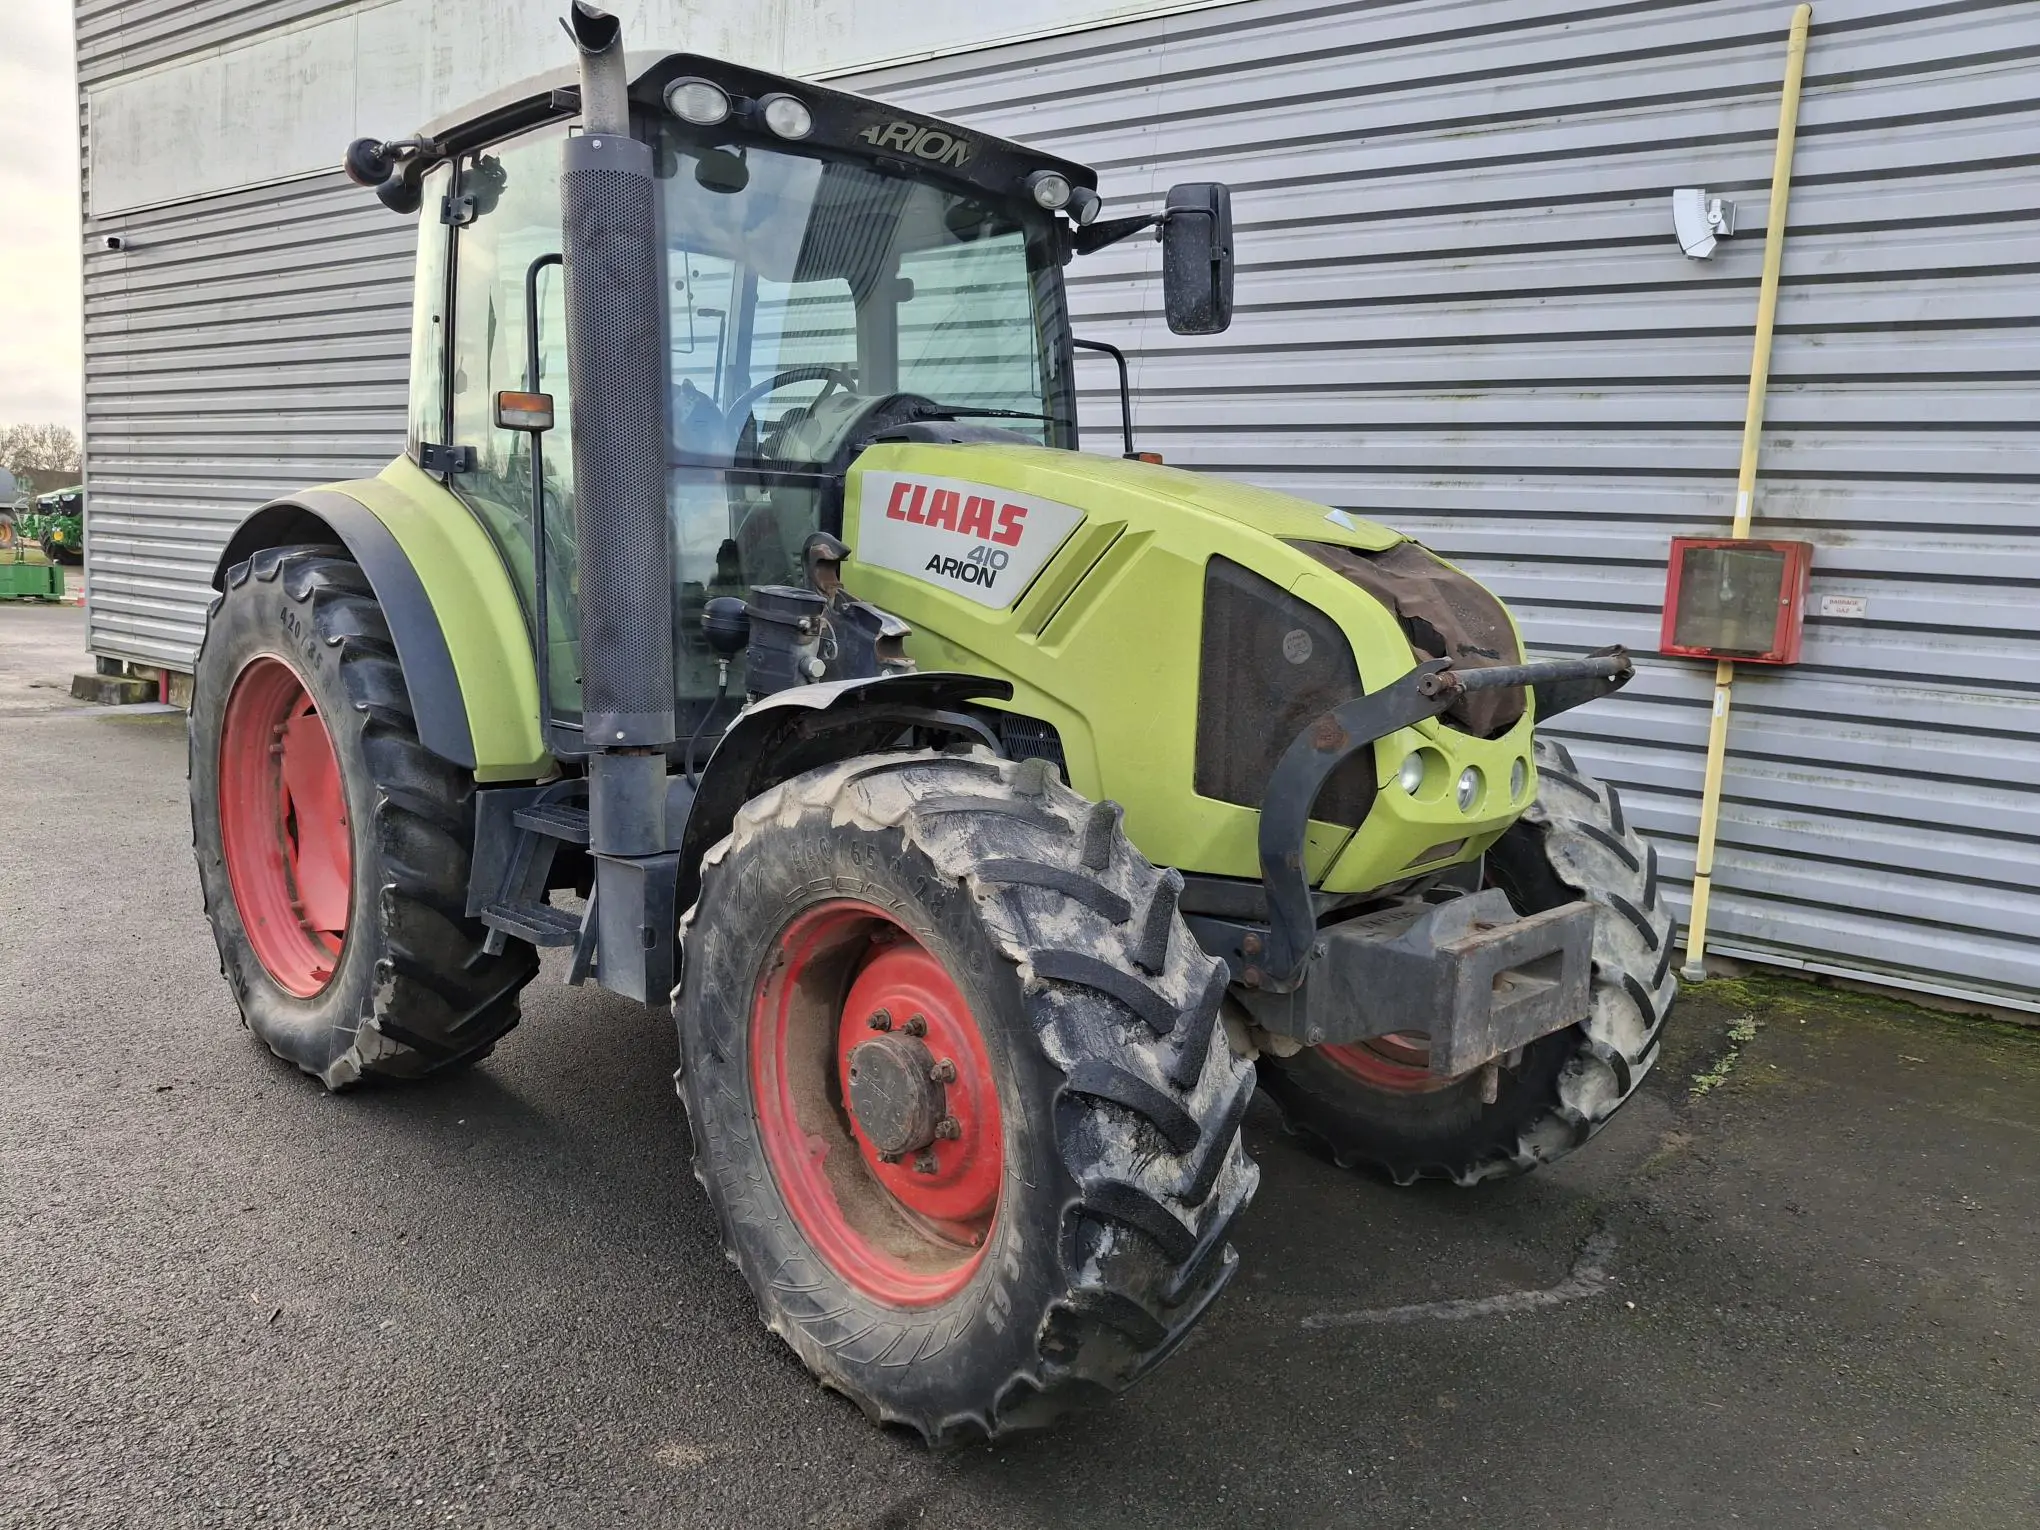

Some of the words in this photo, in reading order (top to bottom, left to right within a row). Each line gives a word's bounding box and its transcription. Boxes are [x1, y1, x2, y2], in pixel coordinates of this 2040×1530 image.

[886, 481, 1028, 547] CLAAS
[925, 554, 997, 588] ARION
[967, 545, 1009, 571] 410
